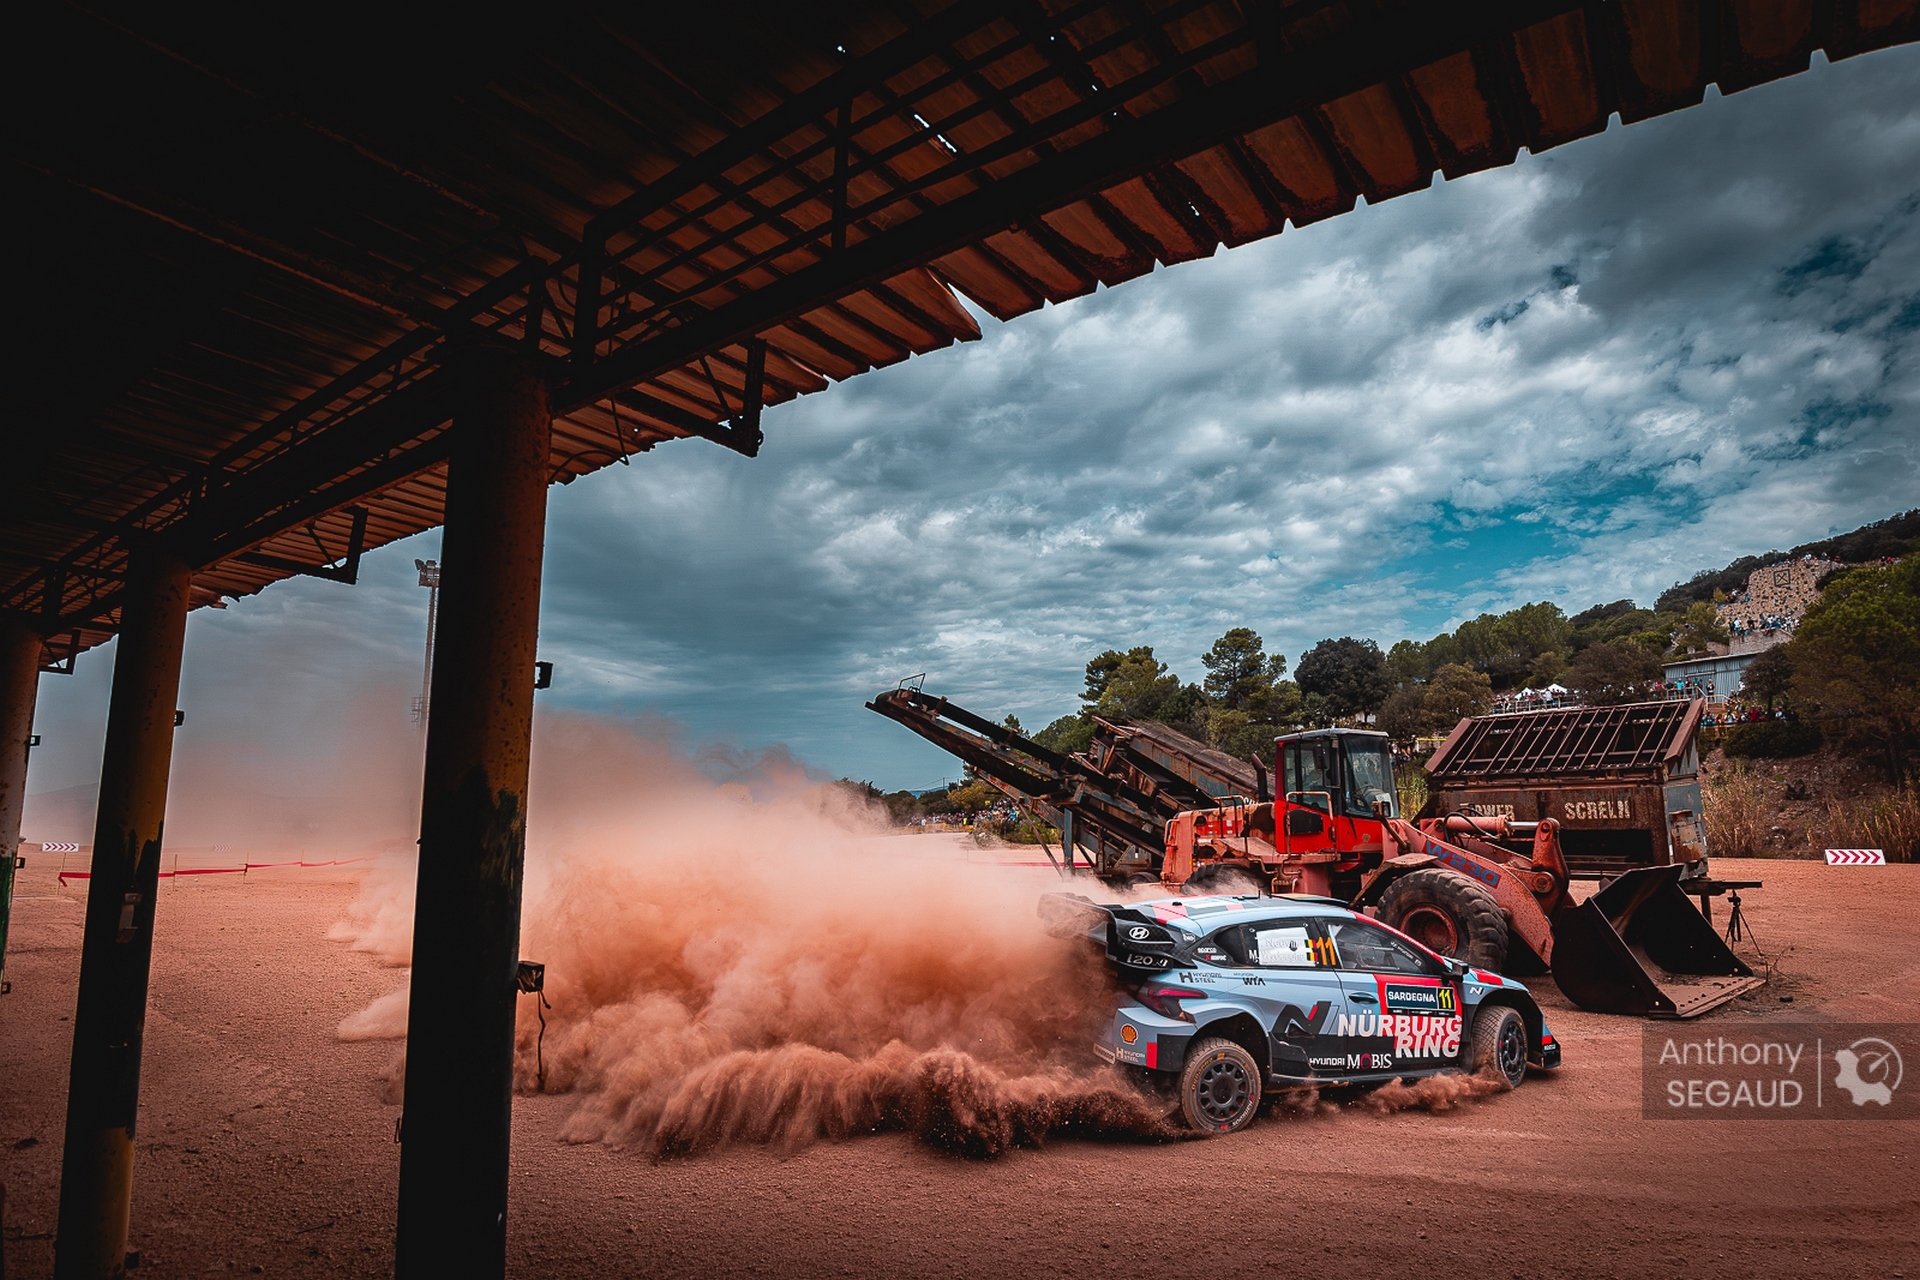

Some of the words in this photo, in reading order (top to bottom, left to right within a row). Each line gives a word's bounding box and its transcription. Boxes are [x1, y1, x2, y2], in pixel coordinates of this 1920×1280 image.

[1426, 840, 1499, 885] W230
[1316, 936, 1336, 965] 11
[1387, 991, 1436, 1003] SARDEGNA
[1439, 989, 1452, 1009] 11
[1337, 1009, 1463, 1038] NÜRBURG
[1395, 1034, 1461, 1059] RING
[1309, 1057, 1345, 1066] HYUNDAI
[1347, 1053, 1393, 1070] MOBIS
